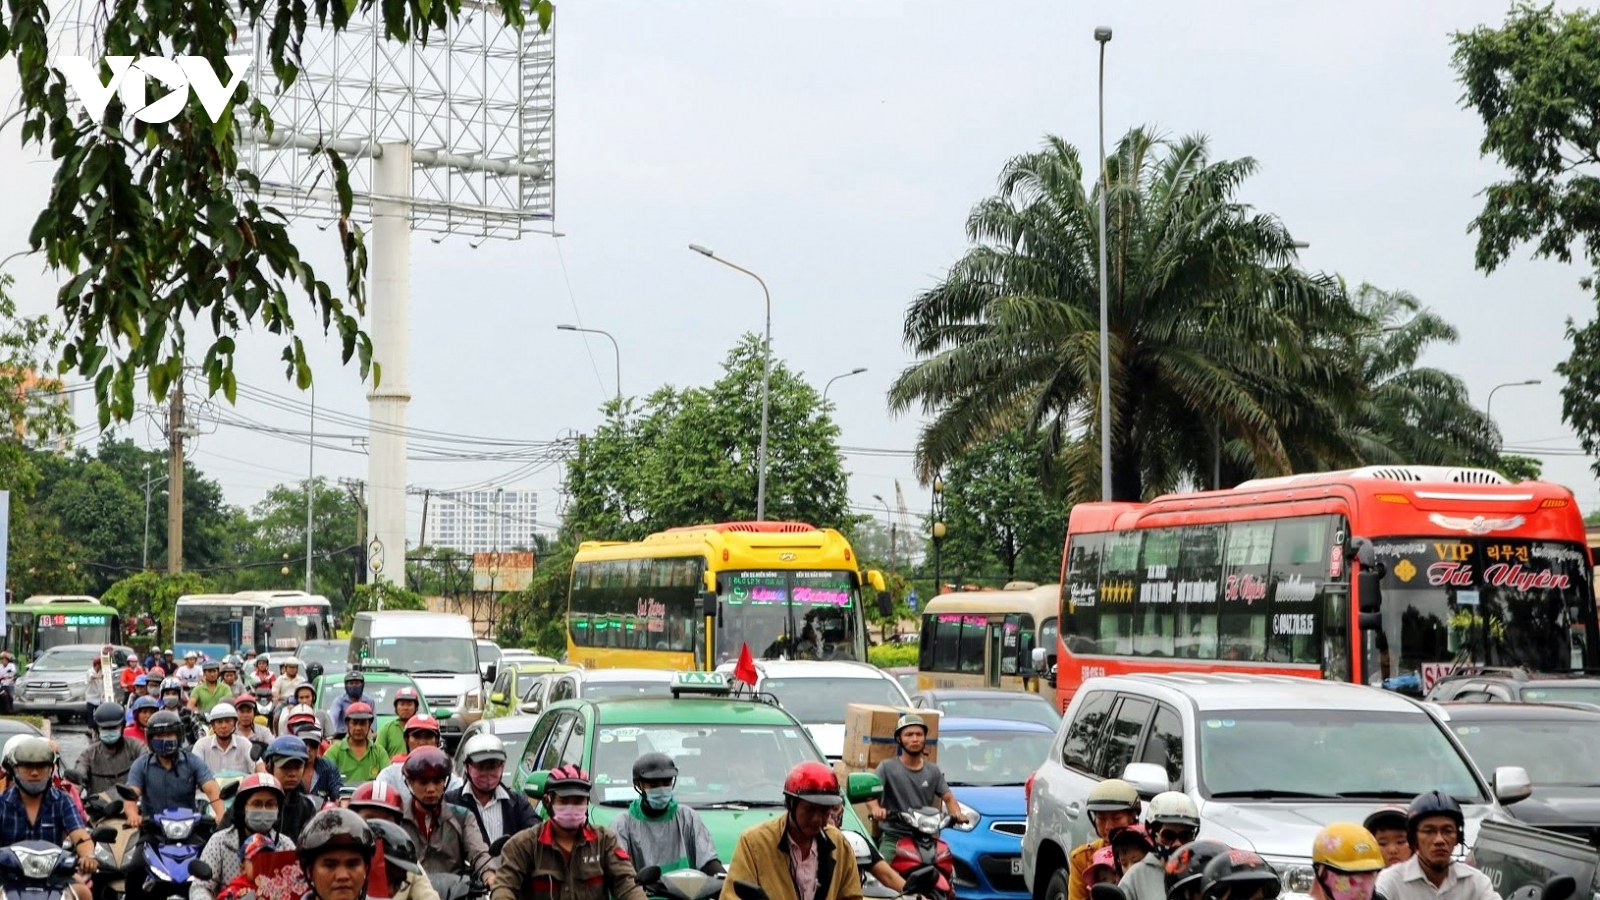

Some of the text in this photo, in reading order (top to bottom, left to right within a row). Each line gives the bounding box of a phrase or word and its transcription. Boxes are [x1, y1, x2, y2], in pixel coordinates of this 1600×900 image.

[1434, 543, 1474, 561] VIP
[1487, 545, 1529, 562] 리무진
[1484, 563, 1571, 592] Uyên
[42, 616, 50, 626] 19
[678, 671, 722, 684] TAXI
[1013, 860, 1020, 873] 5
